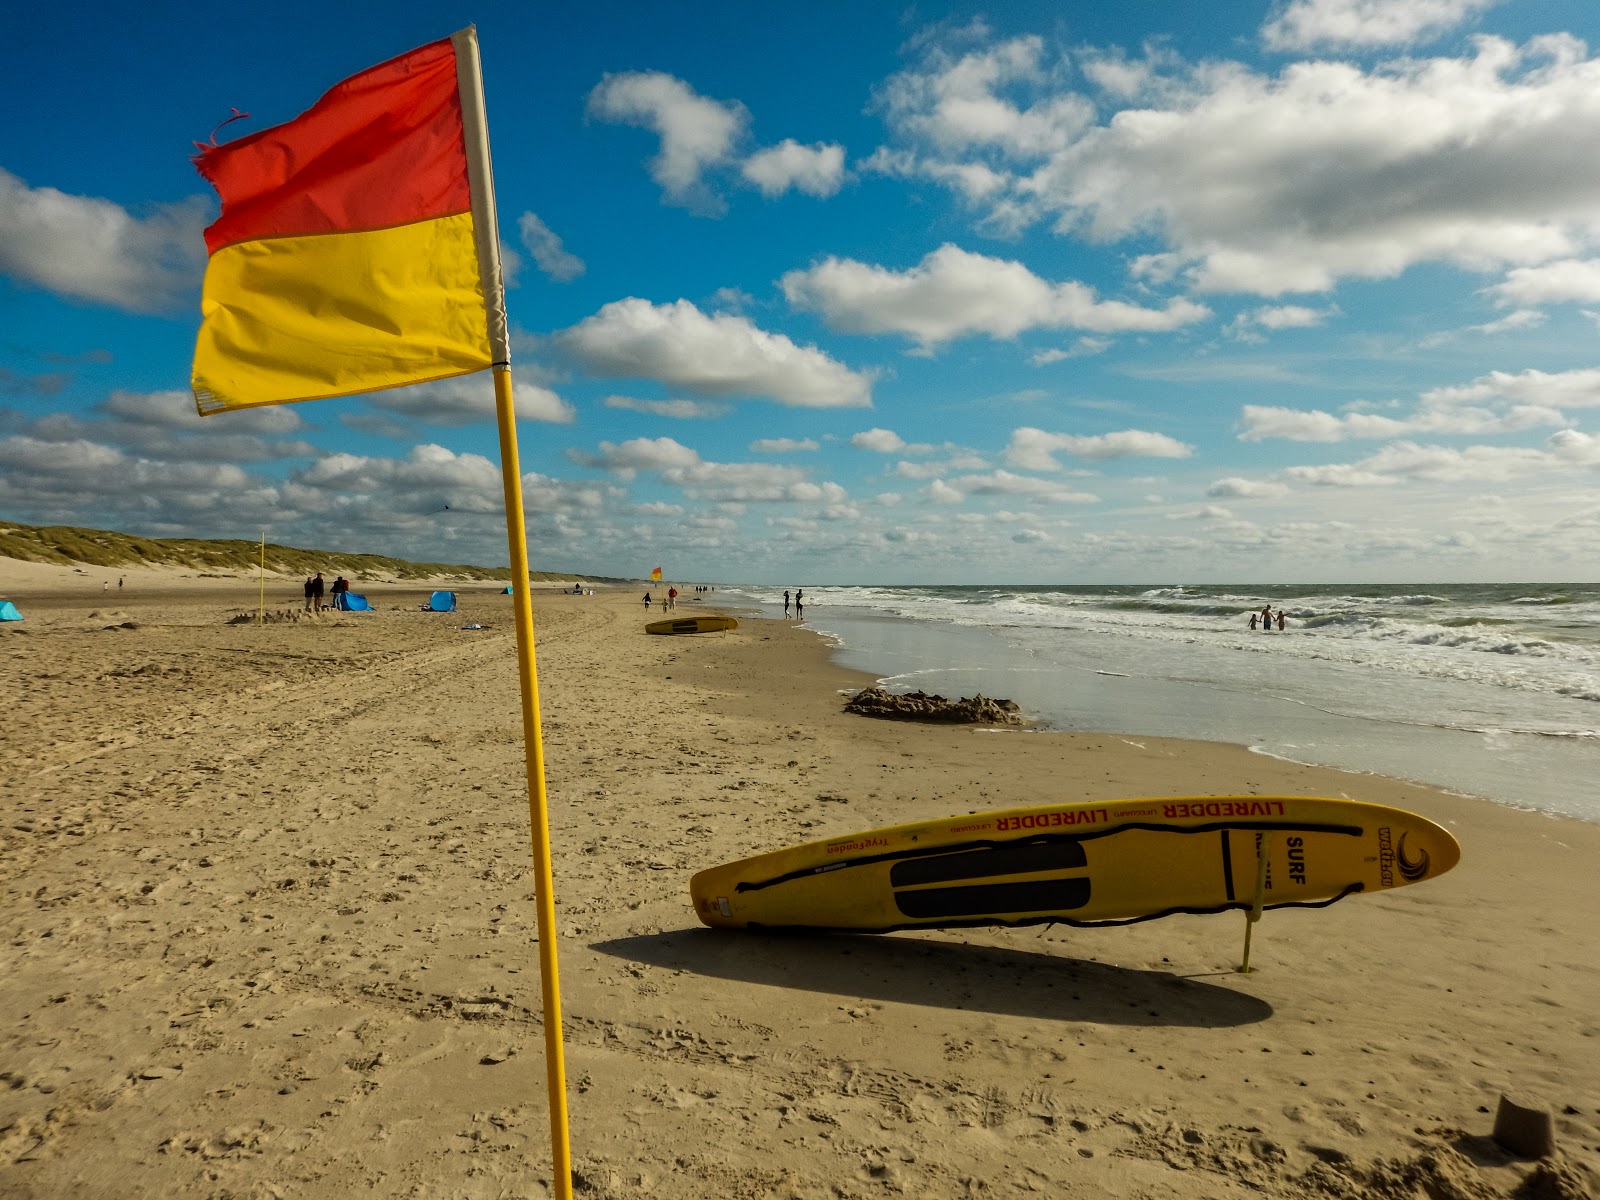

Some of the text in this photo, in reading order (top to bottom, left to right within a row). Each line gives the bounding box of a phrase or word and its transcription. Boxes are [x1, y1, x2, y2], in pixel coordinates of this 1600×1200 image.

[1113, 801, 1285, 818] LIVREDDER LIFEGUARD
[949, 809, 1108, 833] LIVREDDER LIFEGUARD
[828, 838, 888, 854] TrygFonden
[1286, 837, 1306, 885] SURF
